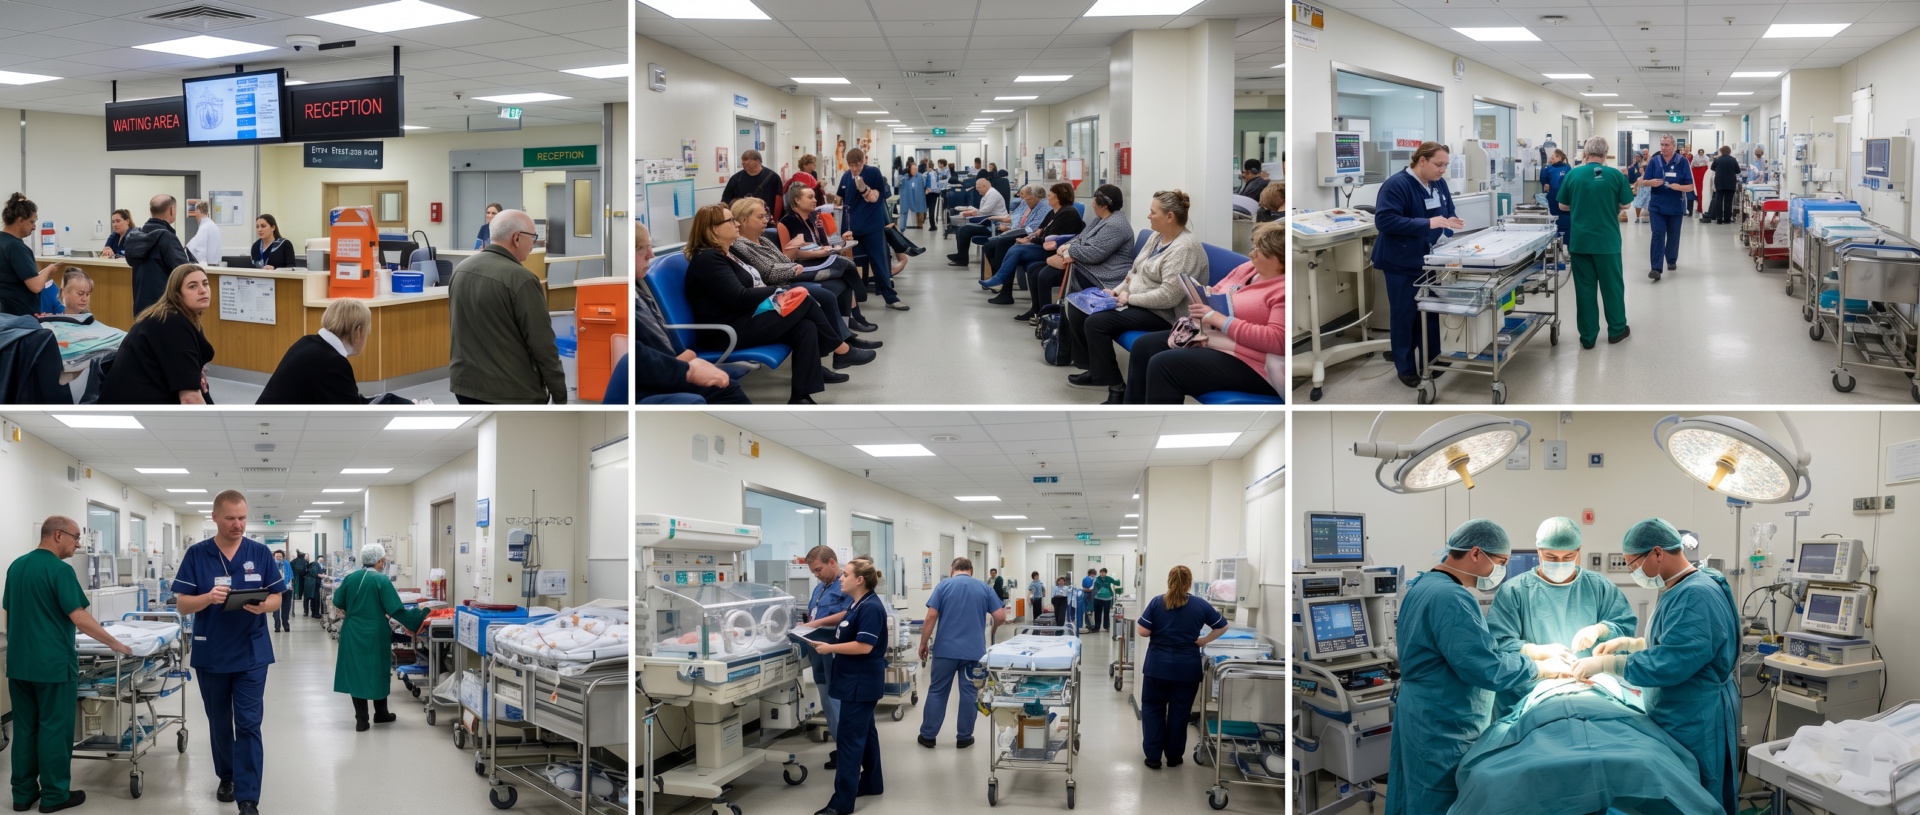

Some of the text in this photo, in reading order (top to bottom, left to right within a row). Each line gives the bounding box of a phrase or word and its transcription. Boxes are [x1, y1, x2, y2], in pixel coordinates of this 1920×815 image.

[304, 97, 382, 119] RECEPTION
[112, 113, 181, 133] WAITING AREA
[537, 150, 584, 161] RECEPTION
